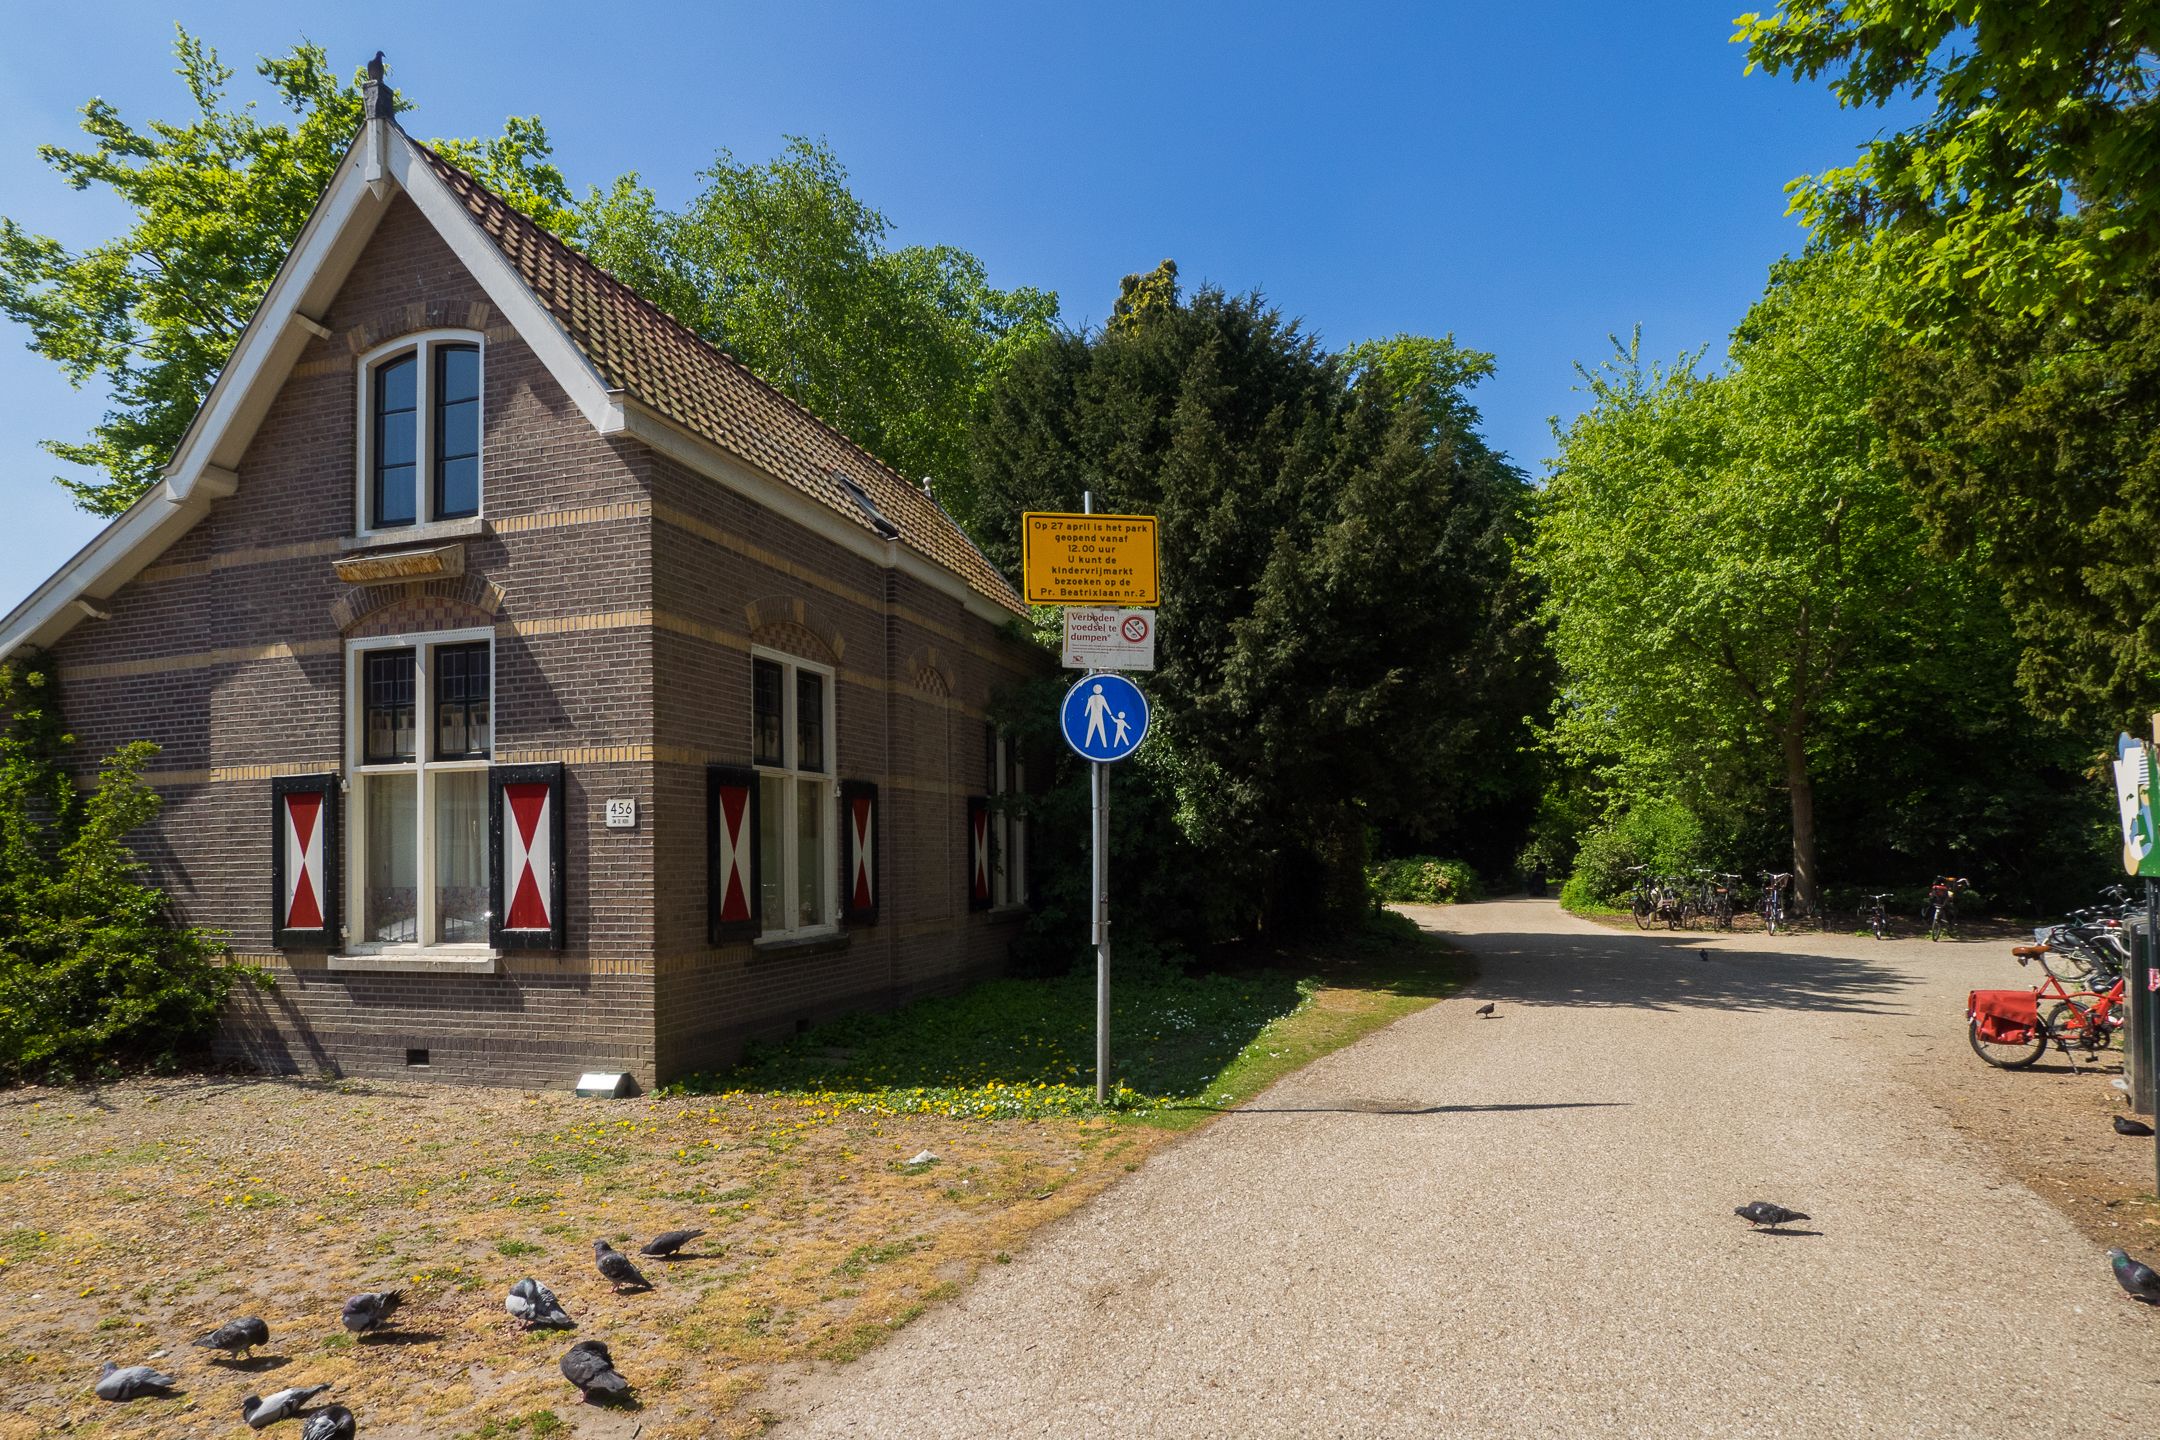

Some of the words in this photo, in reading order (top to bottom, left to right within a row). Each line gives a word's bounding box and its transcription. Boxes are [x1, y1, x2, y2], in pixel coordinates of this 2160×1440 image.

[1034, 522, 1048, 531] Op
[1050, 522, 1064, 530] 27
[1066, 523, 1090, 531] april
[1093, 523, 1103, 531] is
[1106, 523, 1122, 532] het
[1125, 525, 1148, 533] park
[1055, 534, 1096, 543] geopend
[1100, 535, 1128, 543] vanaf
[1068, 544, 1095, 553] 12.00
[1078, 556, 1102, 564] kunt
[1105, 556, 1117, 564] de
[1051, 566, 1133, 577] kindervrijmarkt
[1054, 577, 1101, 586] bezoeken
[1104, 579, 1116, 587] op
[1119, 578, 1131, 586] de
[1040, 588, 1056, 596] Pr.
[1060, 588, 1120, 597] Beatrixlaan
[1071, 612, 1115, 622] Verboden
[1071, 623, 1106, 633] voedsel
[1108, 625, 1117, 633] te
[610, 802, 632, 815] 456
